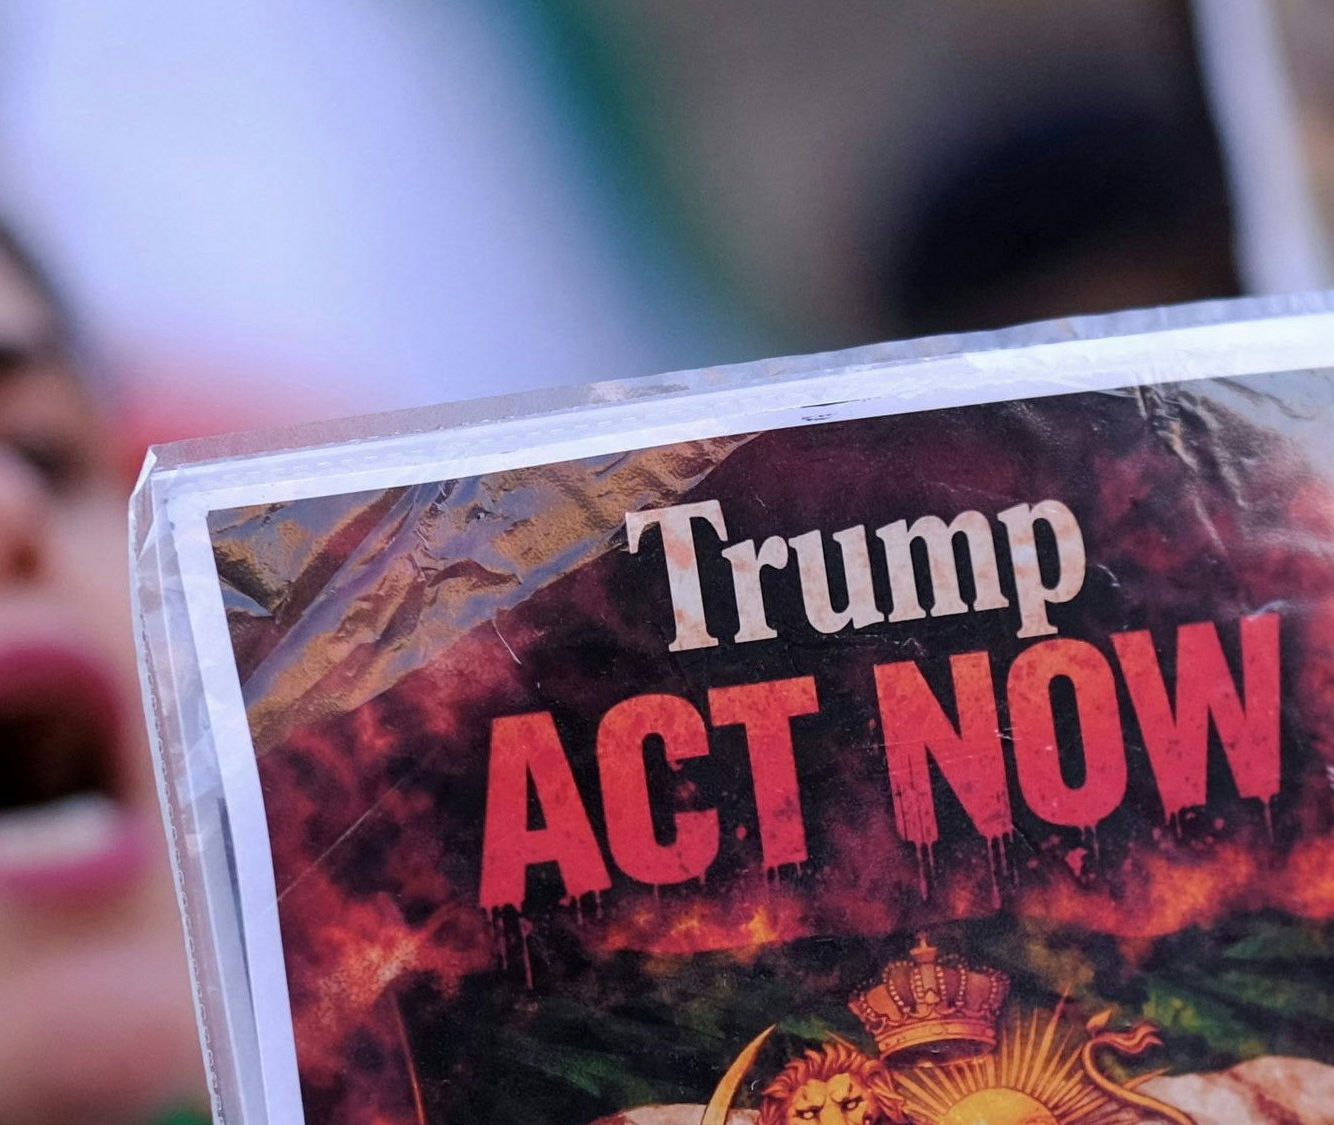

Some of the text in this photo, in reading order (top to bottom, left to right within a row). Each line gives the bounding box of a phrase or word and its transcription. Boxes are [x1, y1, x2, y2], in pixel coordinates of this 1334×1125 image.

[625, 498, 1087, 653] Trump
[479, 613, 1283, 914] ACT NOW
